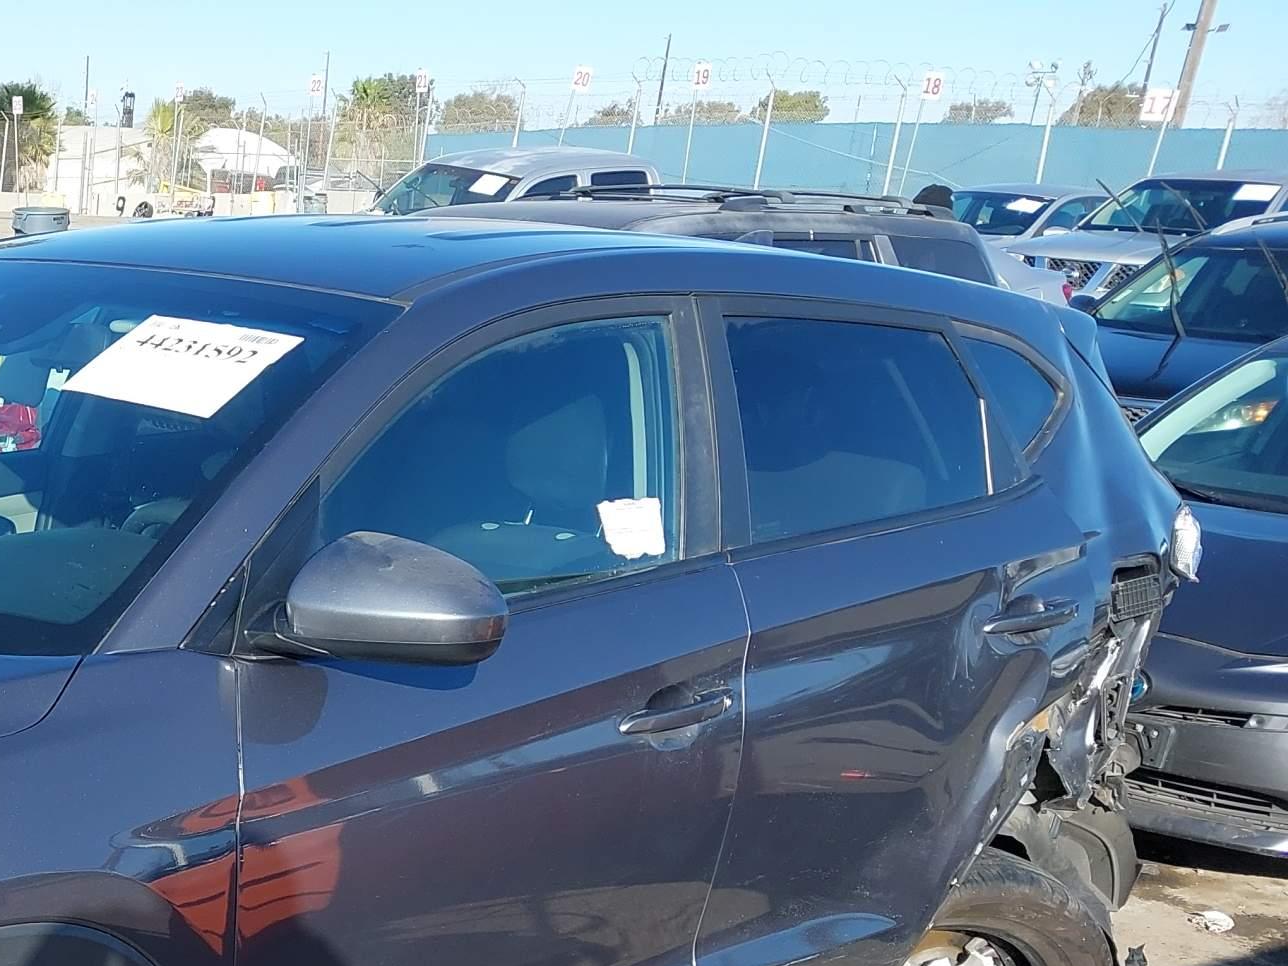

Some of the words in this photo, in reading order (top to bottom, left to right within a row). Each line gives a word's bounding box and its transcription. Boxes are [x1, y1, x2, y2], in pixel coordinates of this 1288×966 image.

[416, 74, 428, 89] 21
[573, 71, 590, 87] 20
[694, 68, 710, 85] 19
[175, 86, 184, 99] 23
[311, 79, 322, 92] 22
[922, 76, 942, 95] 18
[1144, 96, 1172, 115] 17
[136, 332, 259, 365] 44231592
